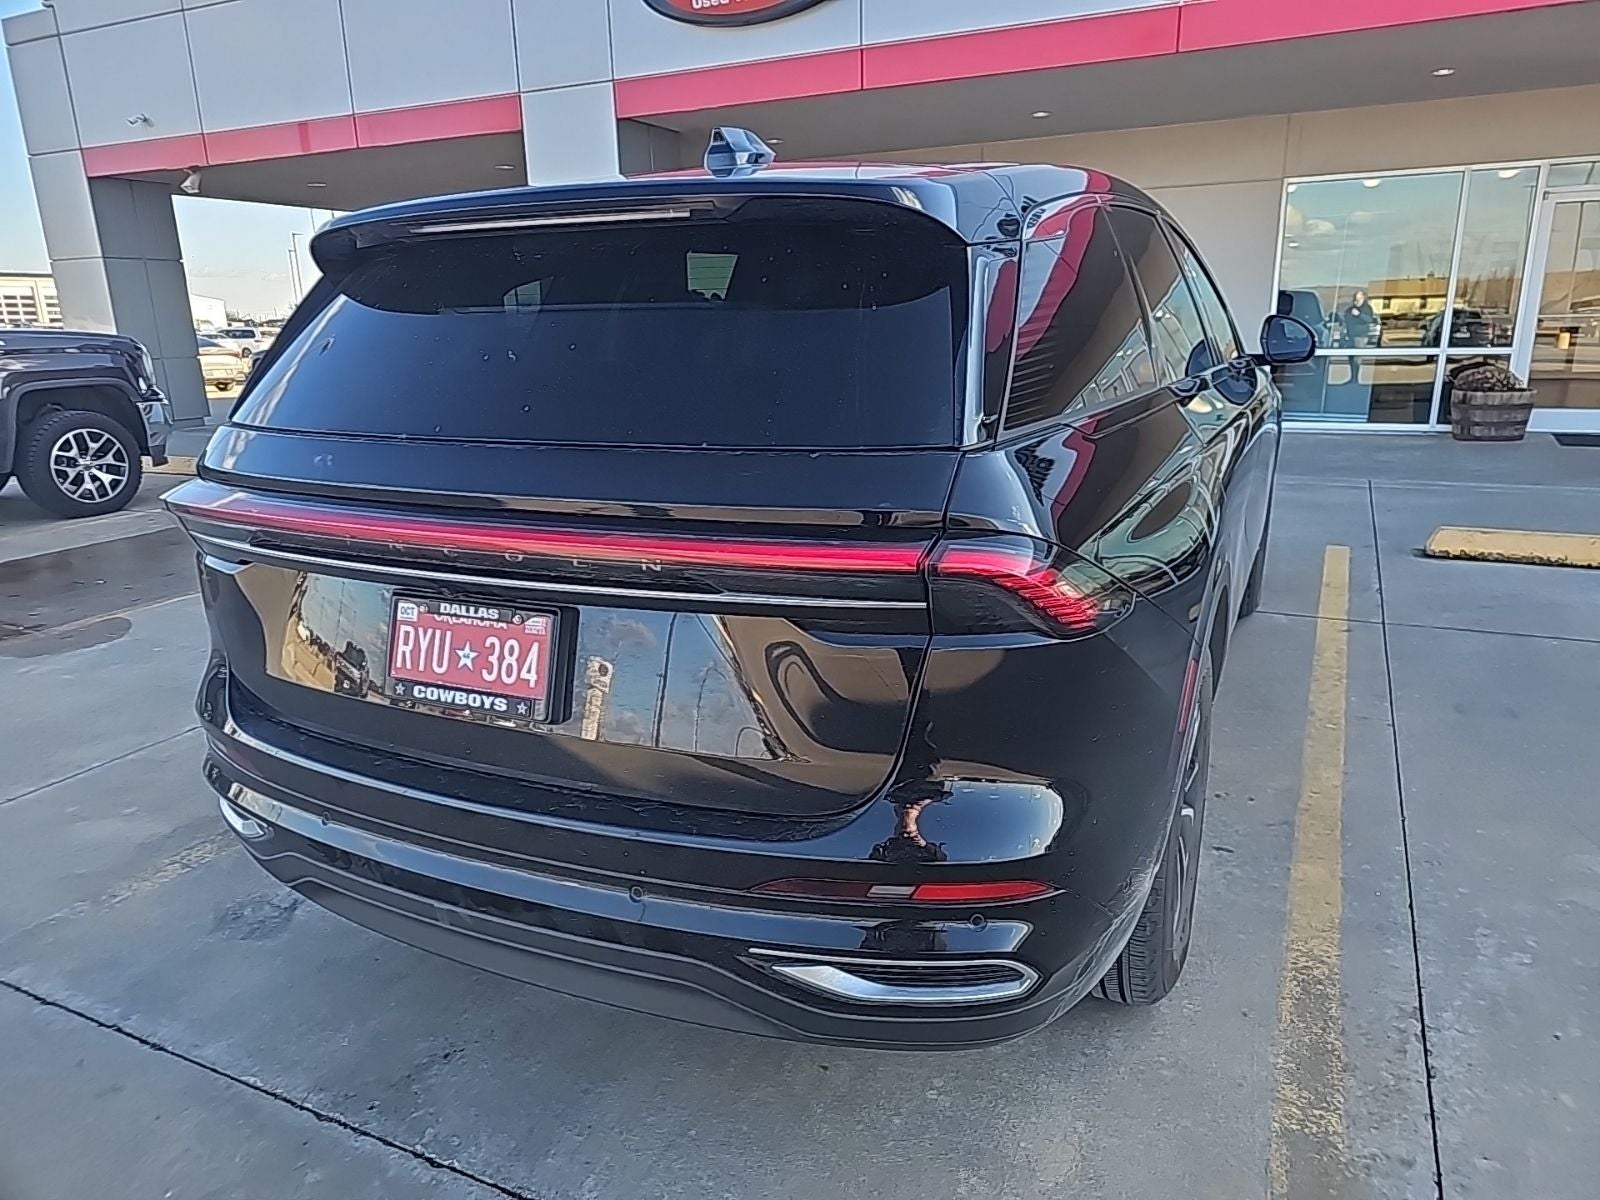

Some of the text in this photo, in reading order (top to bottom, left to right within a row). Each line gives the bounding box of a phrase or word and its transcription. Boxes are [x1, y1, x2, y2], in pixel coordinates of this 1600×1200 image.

[440, 602, 500, 620] DALLAS
[396, 624, 540, 689] RYU 384
[412, 685, 509, 712] COWBOYS
